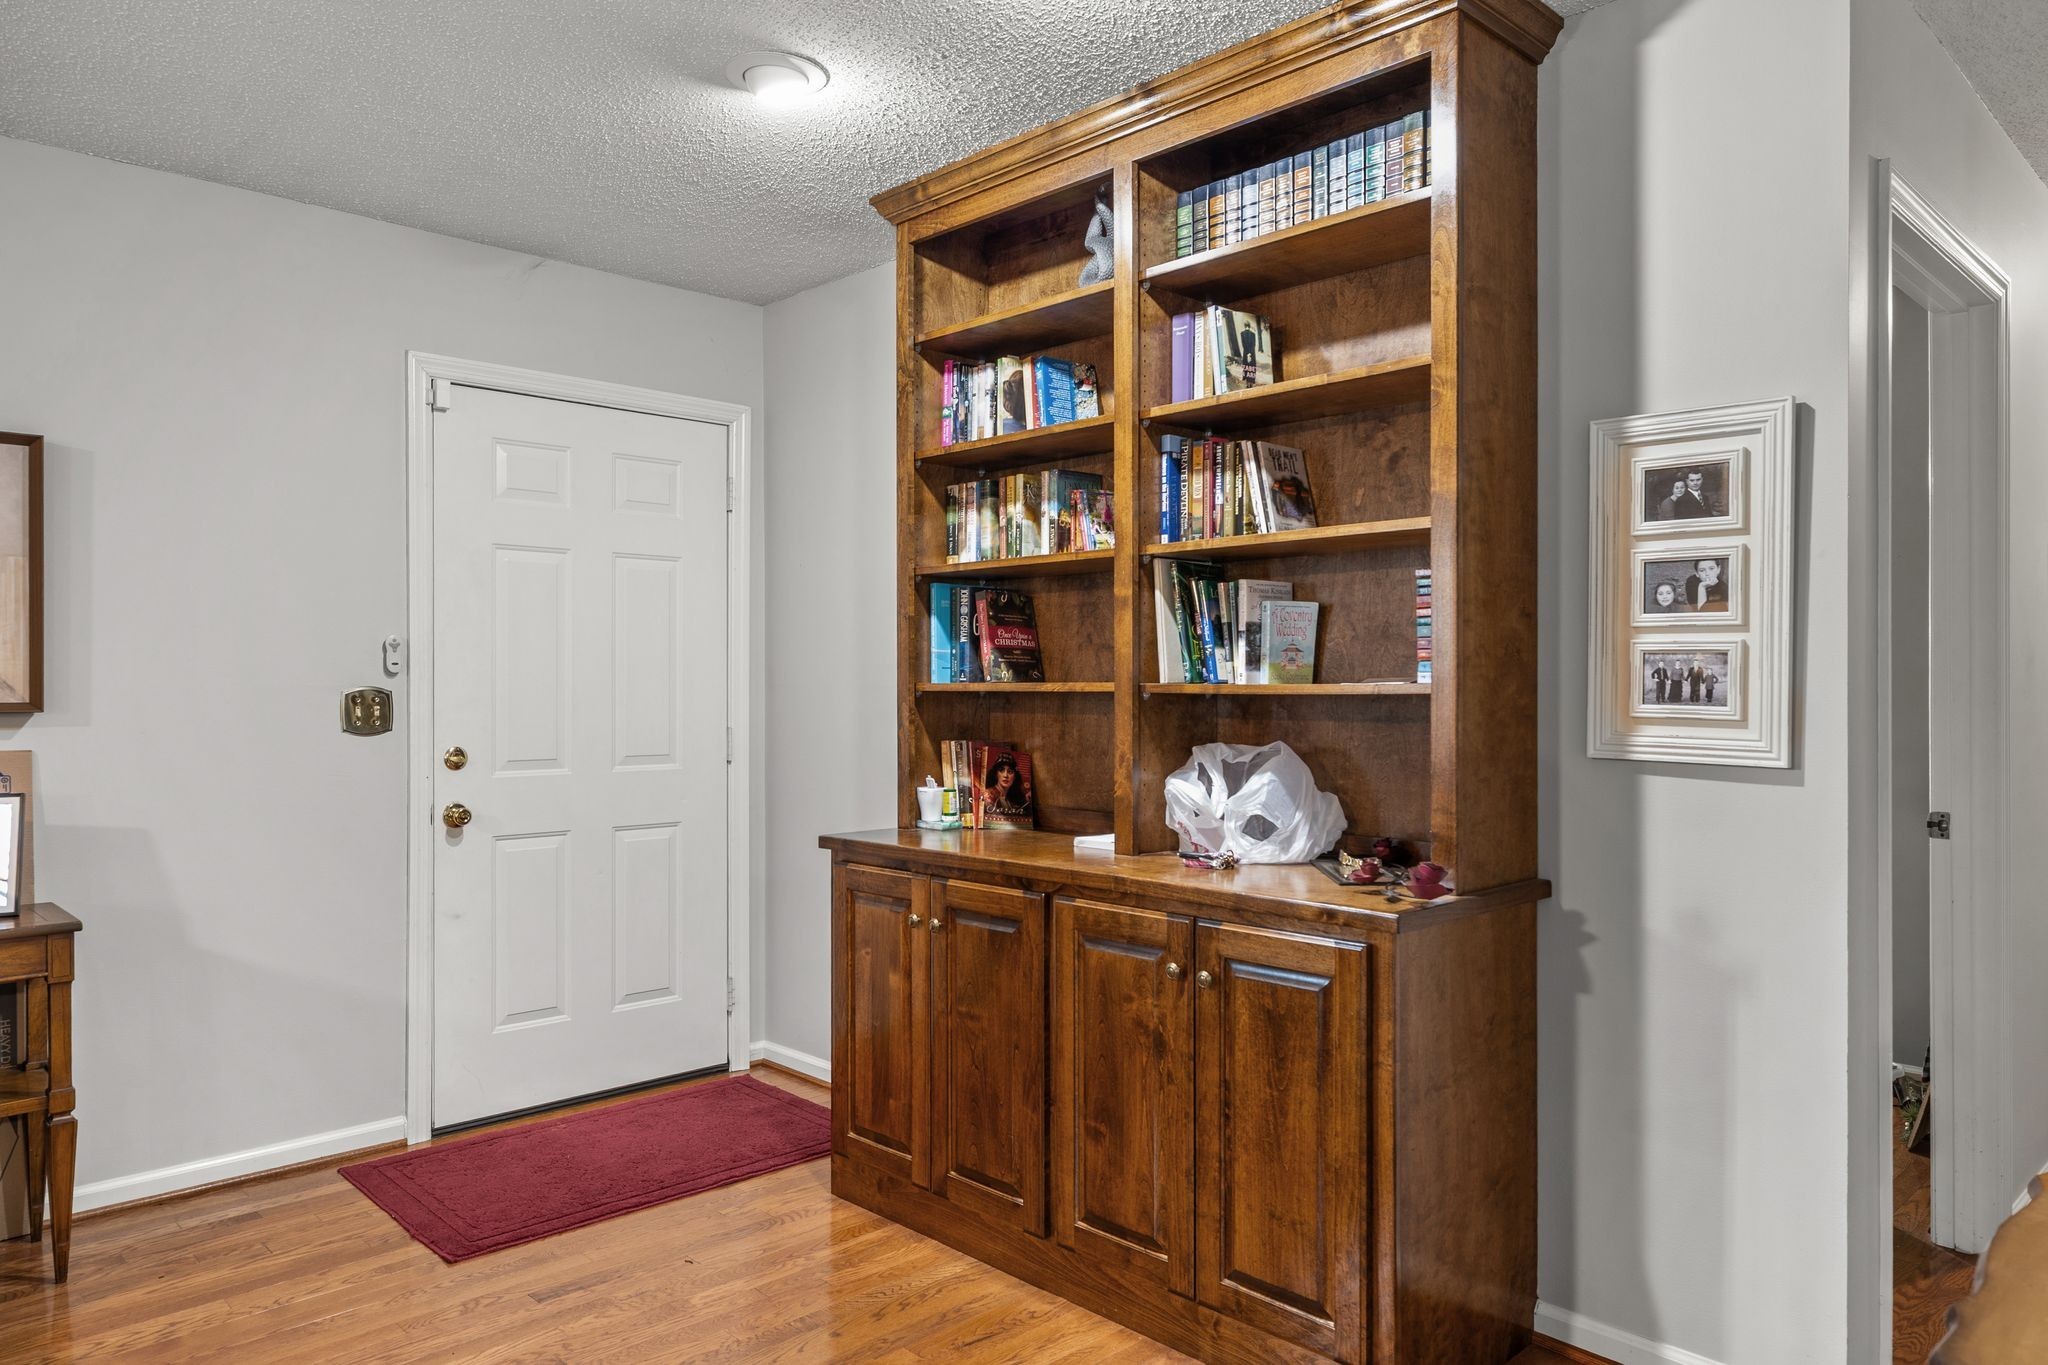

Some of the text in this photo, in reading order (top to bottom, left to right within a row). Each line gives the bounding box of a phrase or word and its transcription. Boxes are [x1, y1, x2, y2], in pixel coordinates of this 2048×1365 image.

[1272, 457, 1299, 475] TRAIL
[1180, 445, 1189, 518] PIRATE DEVLIN
[960, 589, 969, 643] JOHN GRISHAM
[997, 628, 1011, 639] Once
[1012, 627, 1028, 641] Upon
[1276, 622, 1307, 641] Wedding
[995, 638, 1036, 648] CHRISTMAS
[987, 798, 1029, 814] Sarah
[0, 1019, 11, 1053] HEAVY
